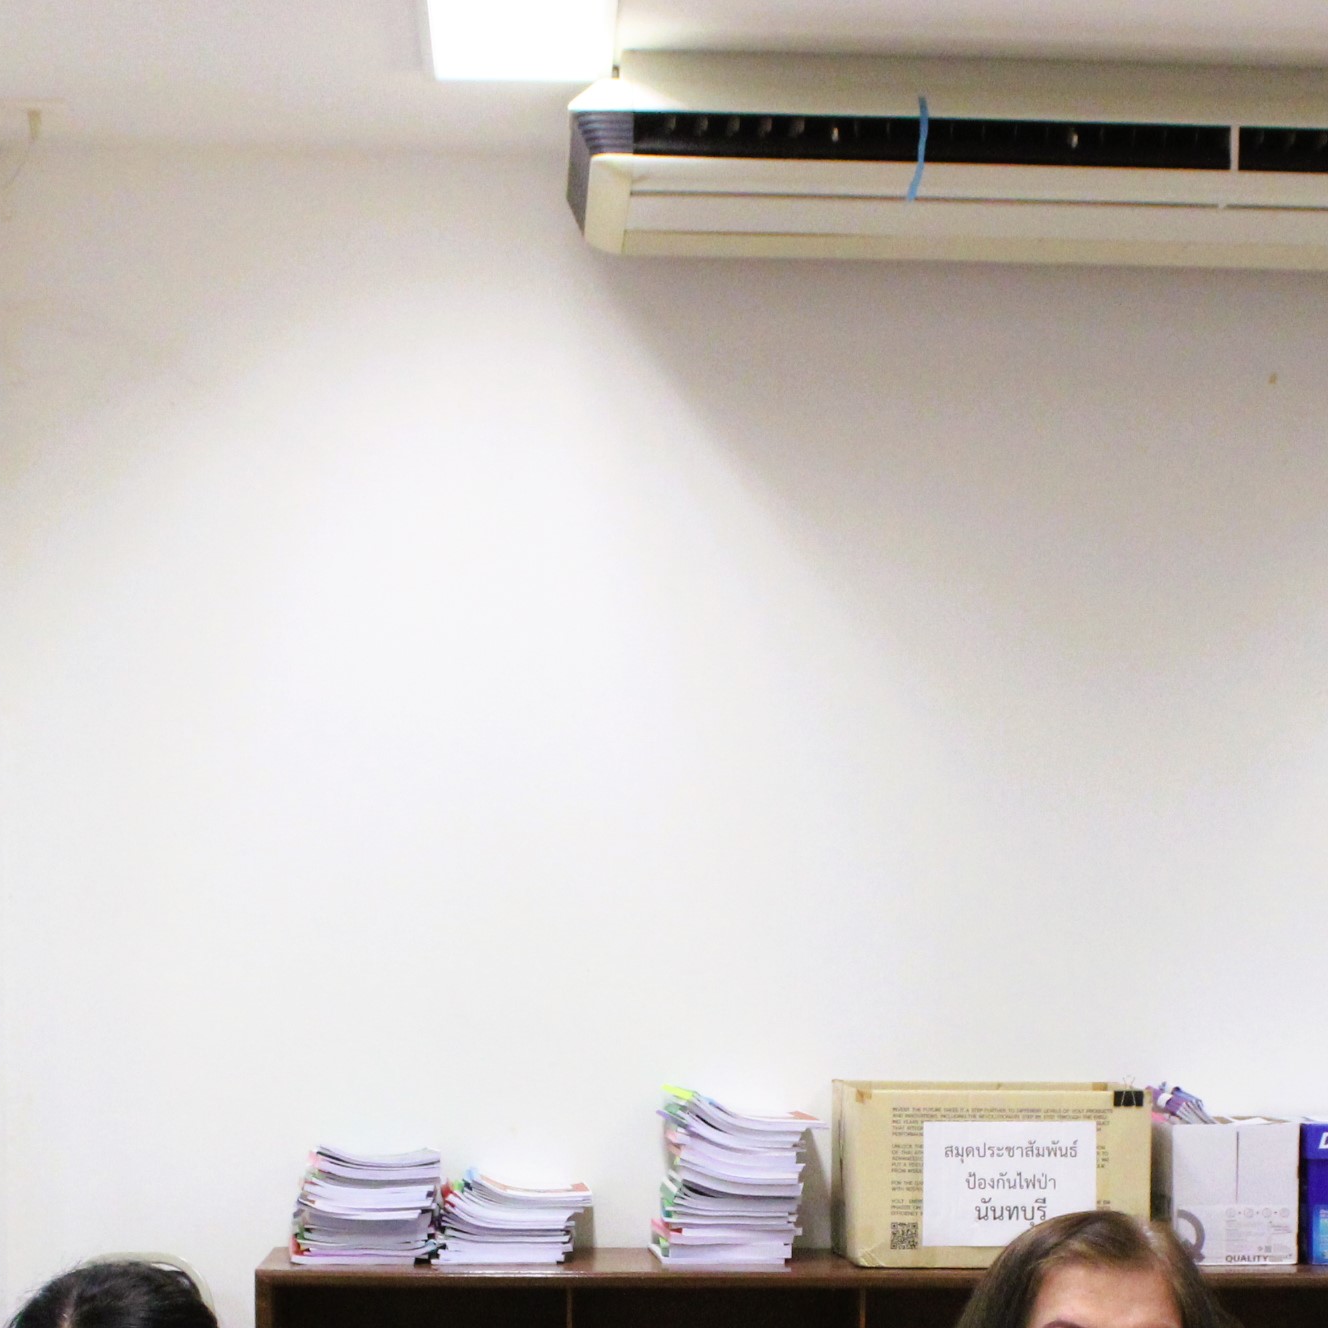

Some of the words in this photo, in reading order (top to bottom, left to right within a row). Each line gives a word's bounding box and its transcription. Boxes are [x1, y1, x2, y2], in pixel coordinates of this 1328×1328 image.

[944, 1139, 1078, 1164] สมุดประชาสัมพันธ์
[965, 1171, 1057, 1191] ป้องกันไฟป่า
[974, 1197, 1048, 1227] นันทบุรี
[1225, 1255, 1269, 1263] QUALITY
